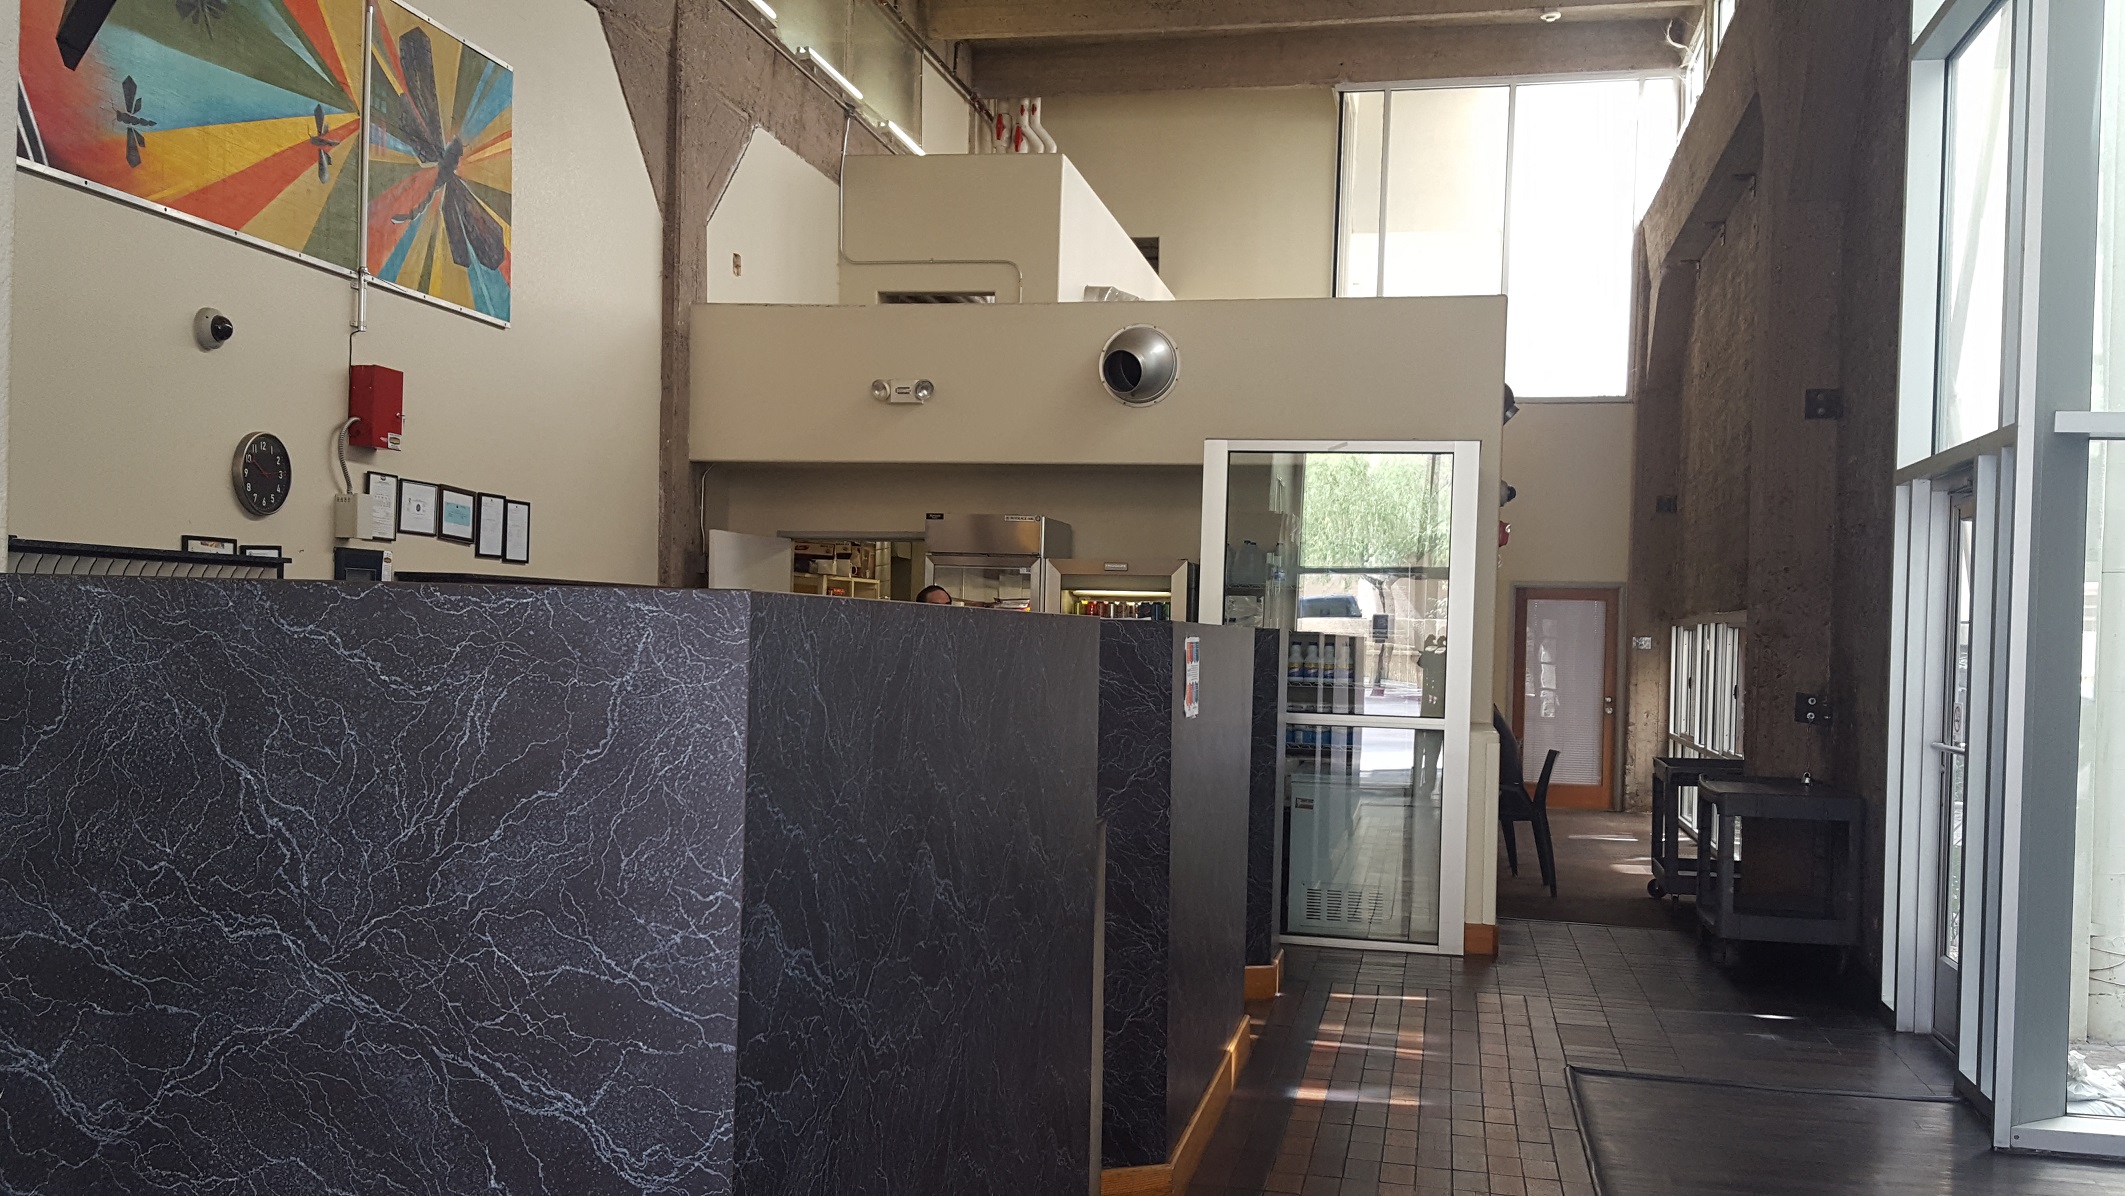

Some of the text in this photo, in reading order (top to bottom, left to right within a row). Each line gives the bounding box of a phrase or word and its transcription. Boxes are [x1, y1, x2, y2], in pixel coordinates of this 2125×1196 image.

[260, 441, 267, 451] 12
[270, 445, 274, 455] 1
[276, 456, 281, 465] 2
[244, 468, 249, 478] 9
[278, 470, 283, 479] 3
[246, 482, 252, 492] 8
[276, 484, 281, 493] 4
[253, 493, 258, 503] 7
[262, 497, 267, 506] 6
[270, 494, 275, 503] 5
